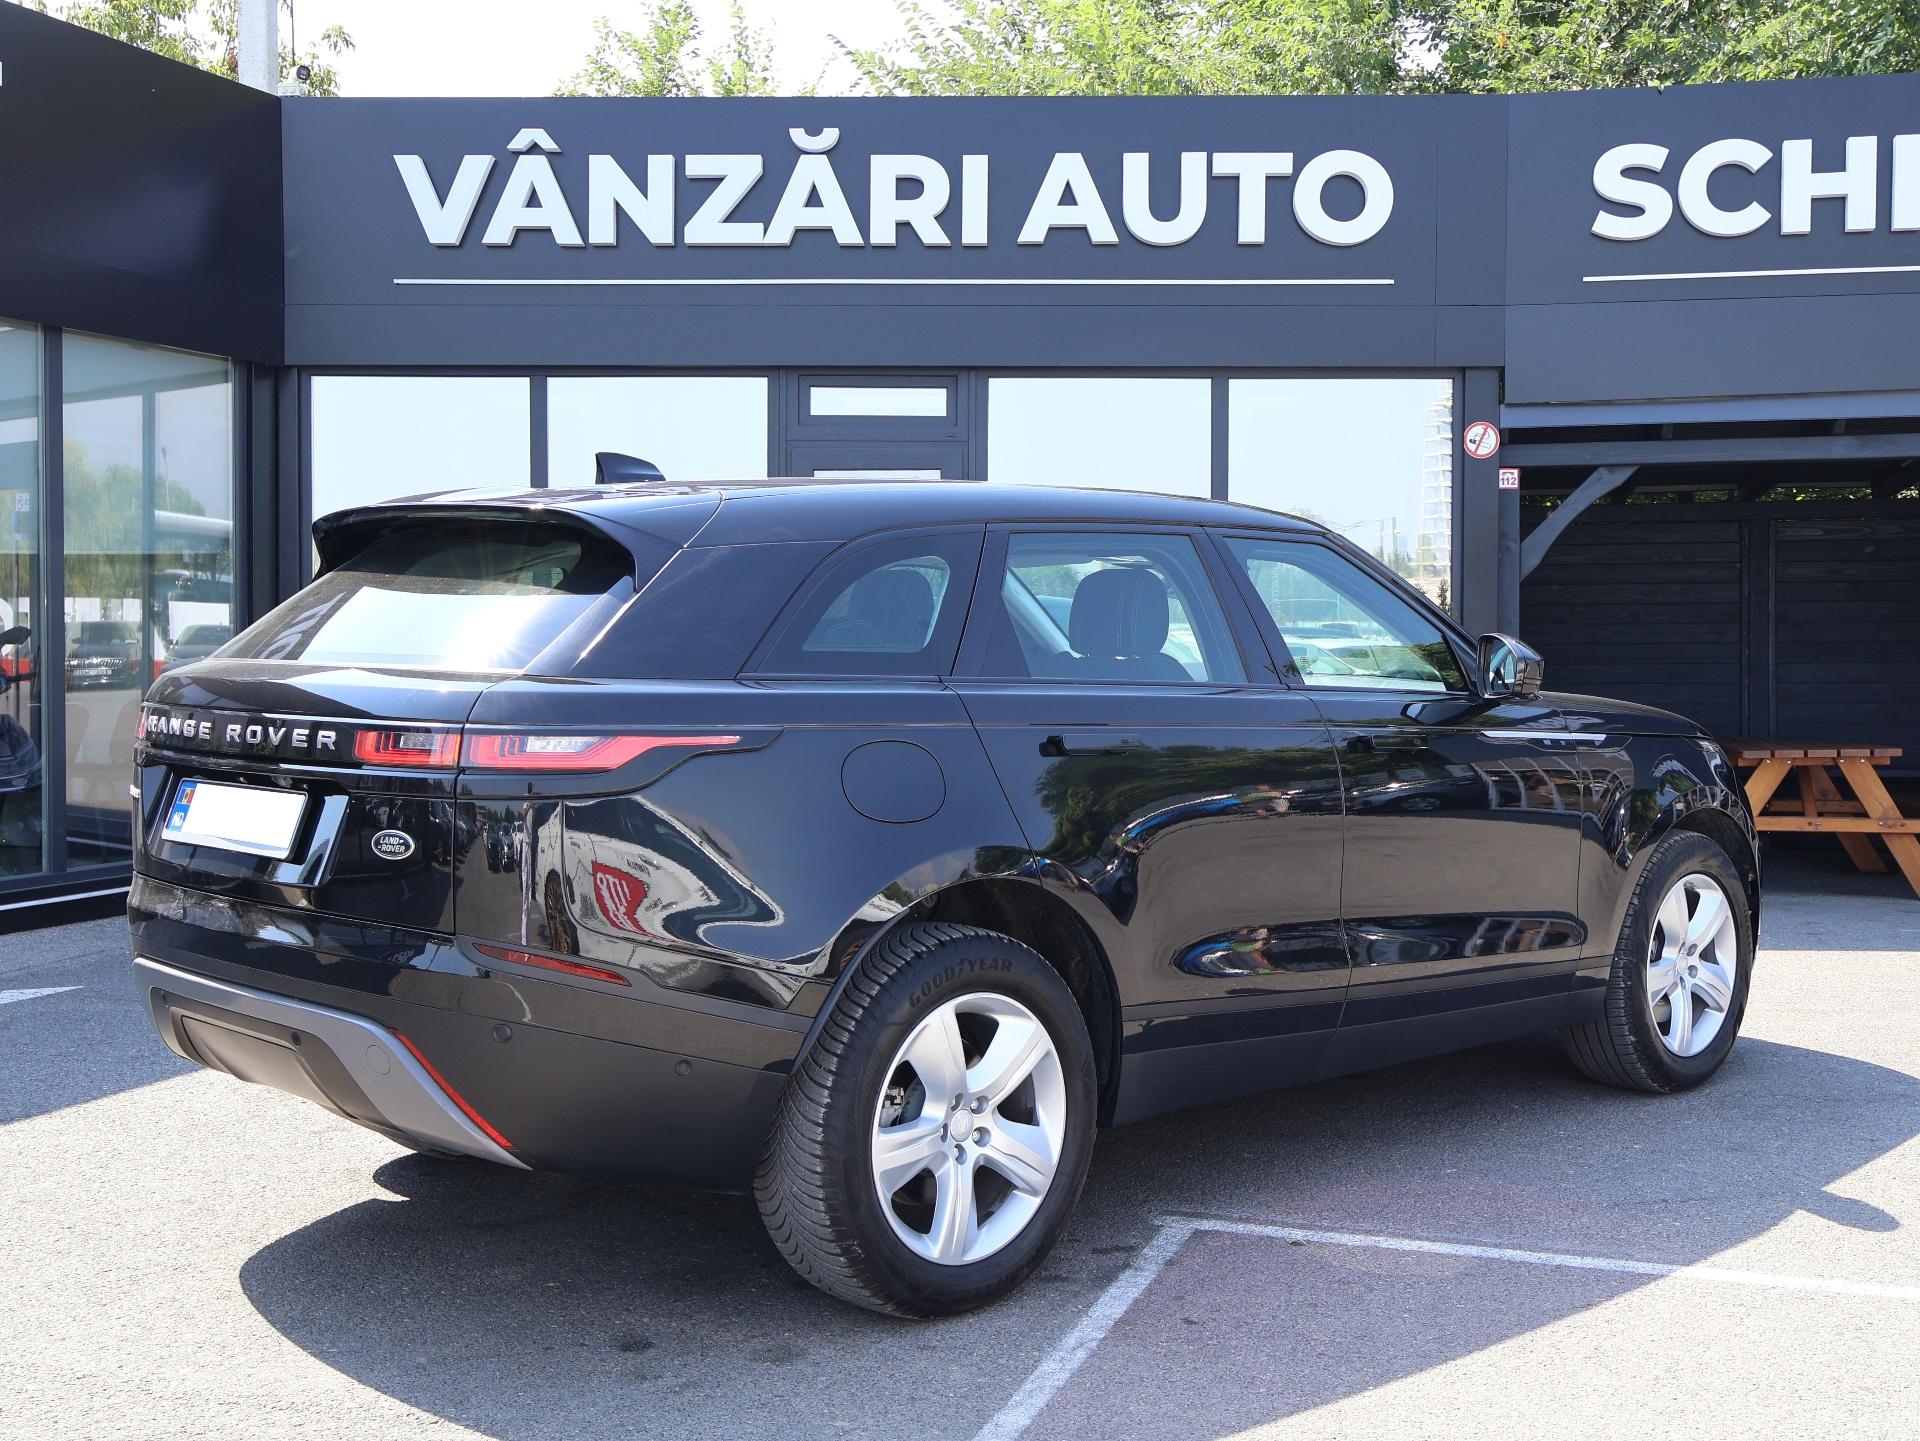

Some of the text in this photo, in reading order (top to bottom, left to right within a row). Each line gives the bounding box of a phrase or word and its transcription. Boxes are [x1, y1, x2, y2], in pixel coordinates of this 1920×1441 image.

[392, 127, 1395, 247] VÂNZĂRI AUTO
[1500, 476, 1517, 486] 112
[147, 714, 337, 750] RANGE ROVER
[380, 843, 406, 853] ROVER
[907, 957, 1013, 1008] GOODYEAR
